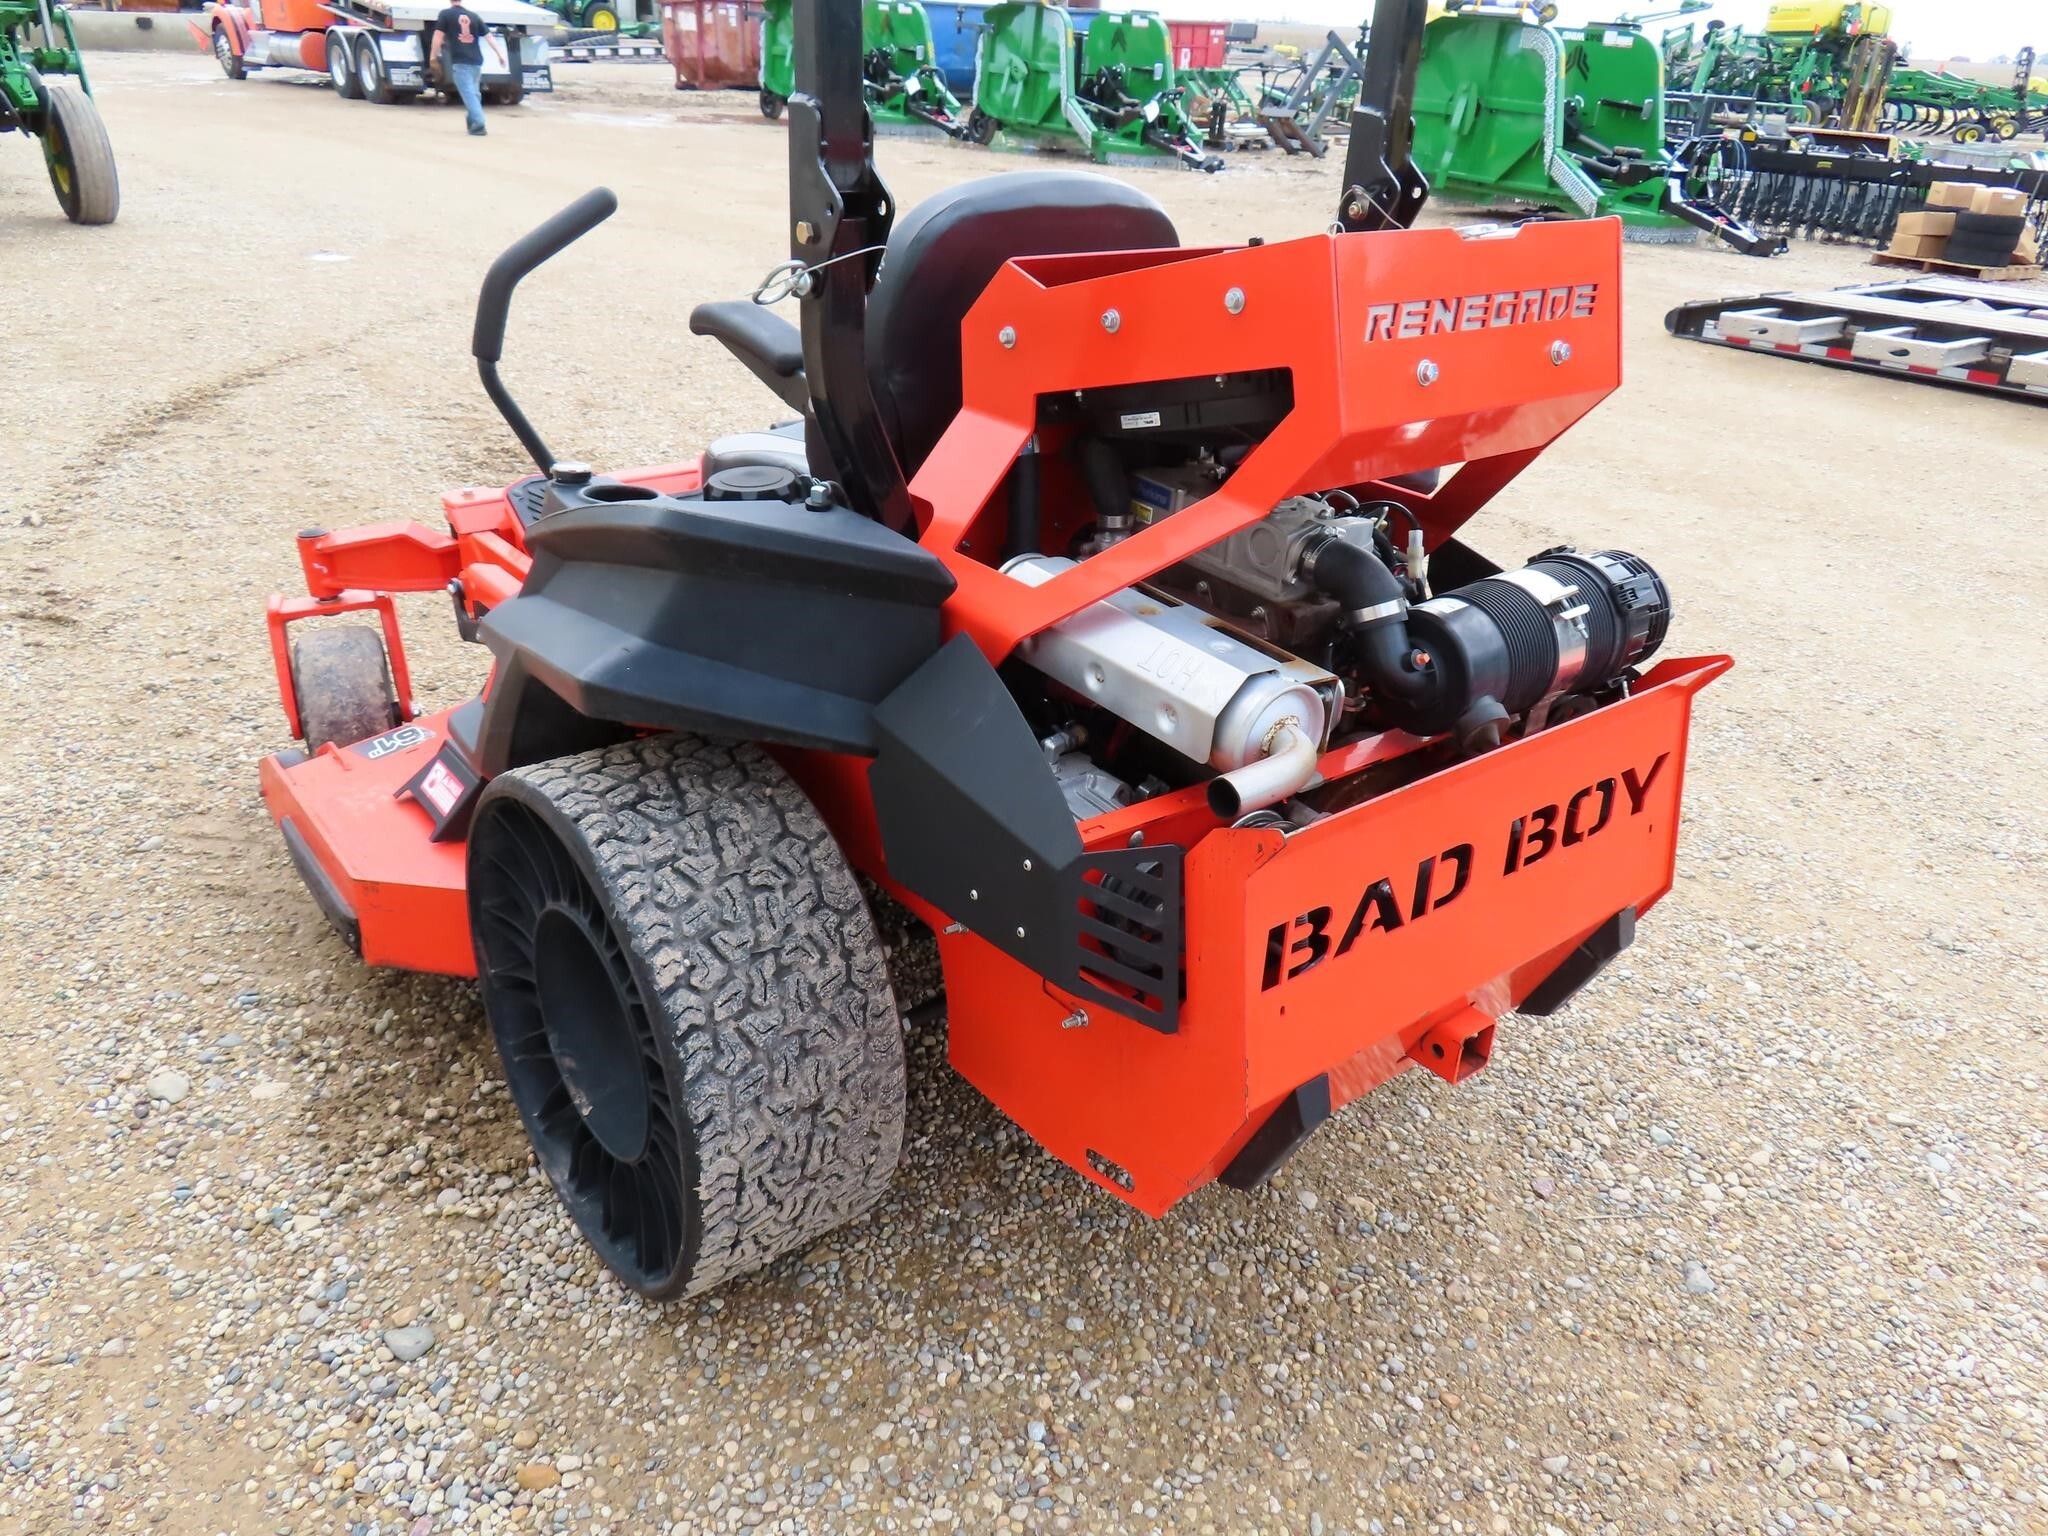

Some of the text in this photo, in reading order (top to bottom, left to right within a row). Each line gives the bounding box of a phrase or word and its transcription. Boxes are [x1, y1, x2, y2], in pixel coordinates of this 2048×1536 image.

[1363, 284, 1598, 342] RENEGADE
[1261, 752, 1670, 992] BAD BOY
